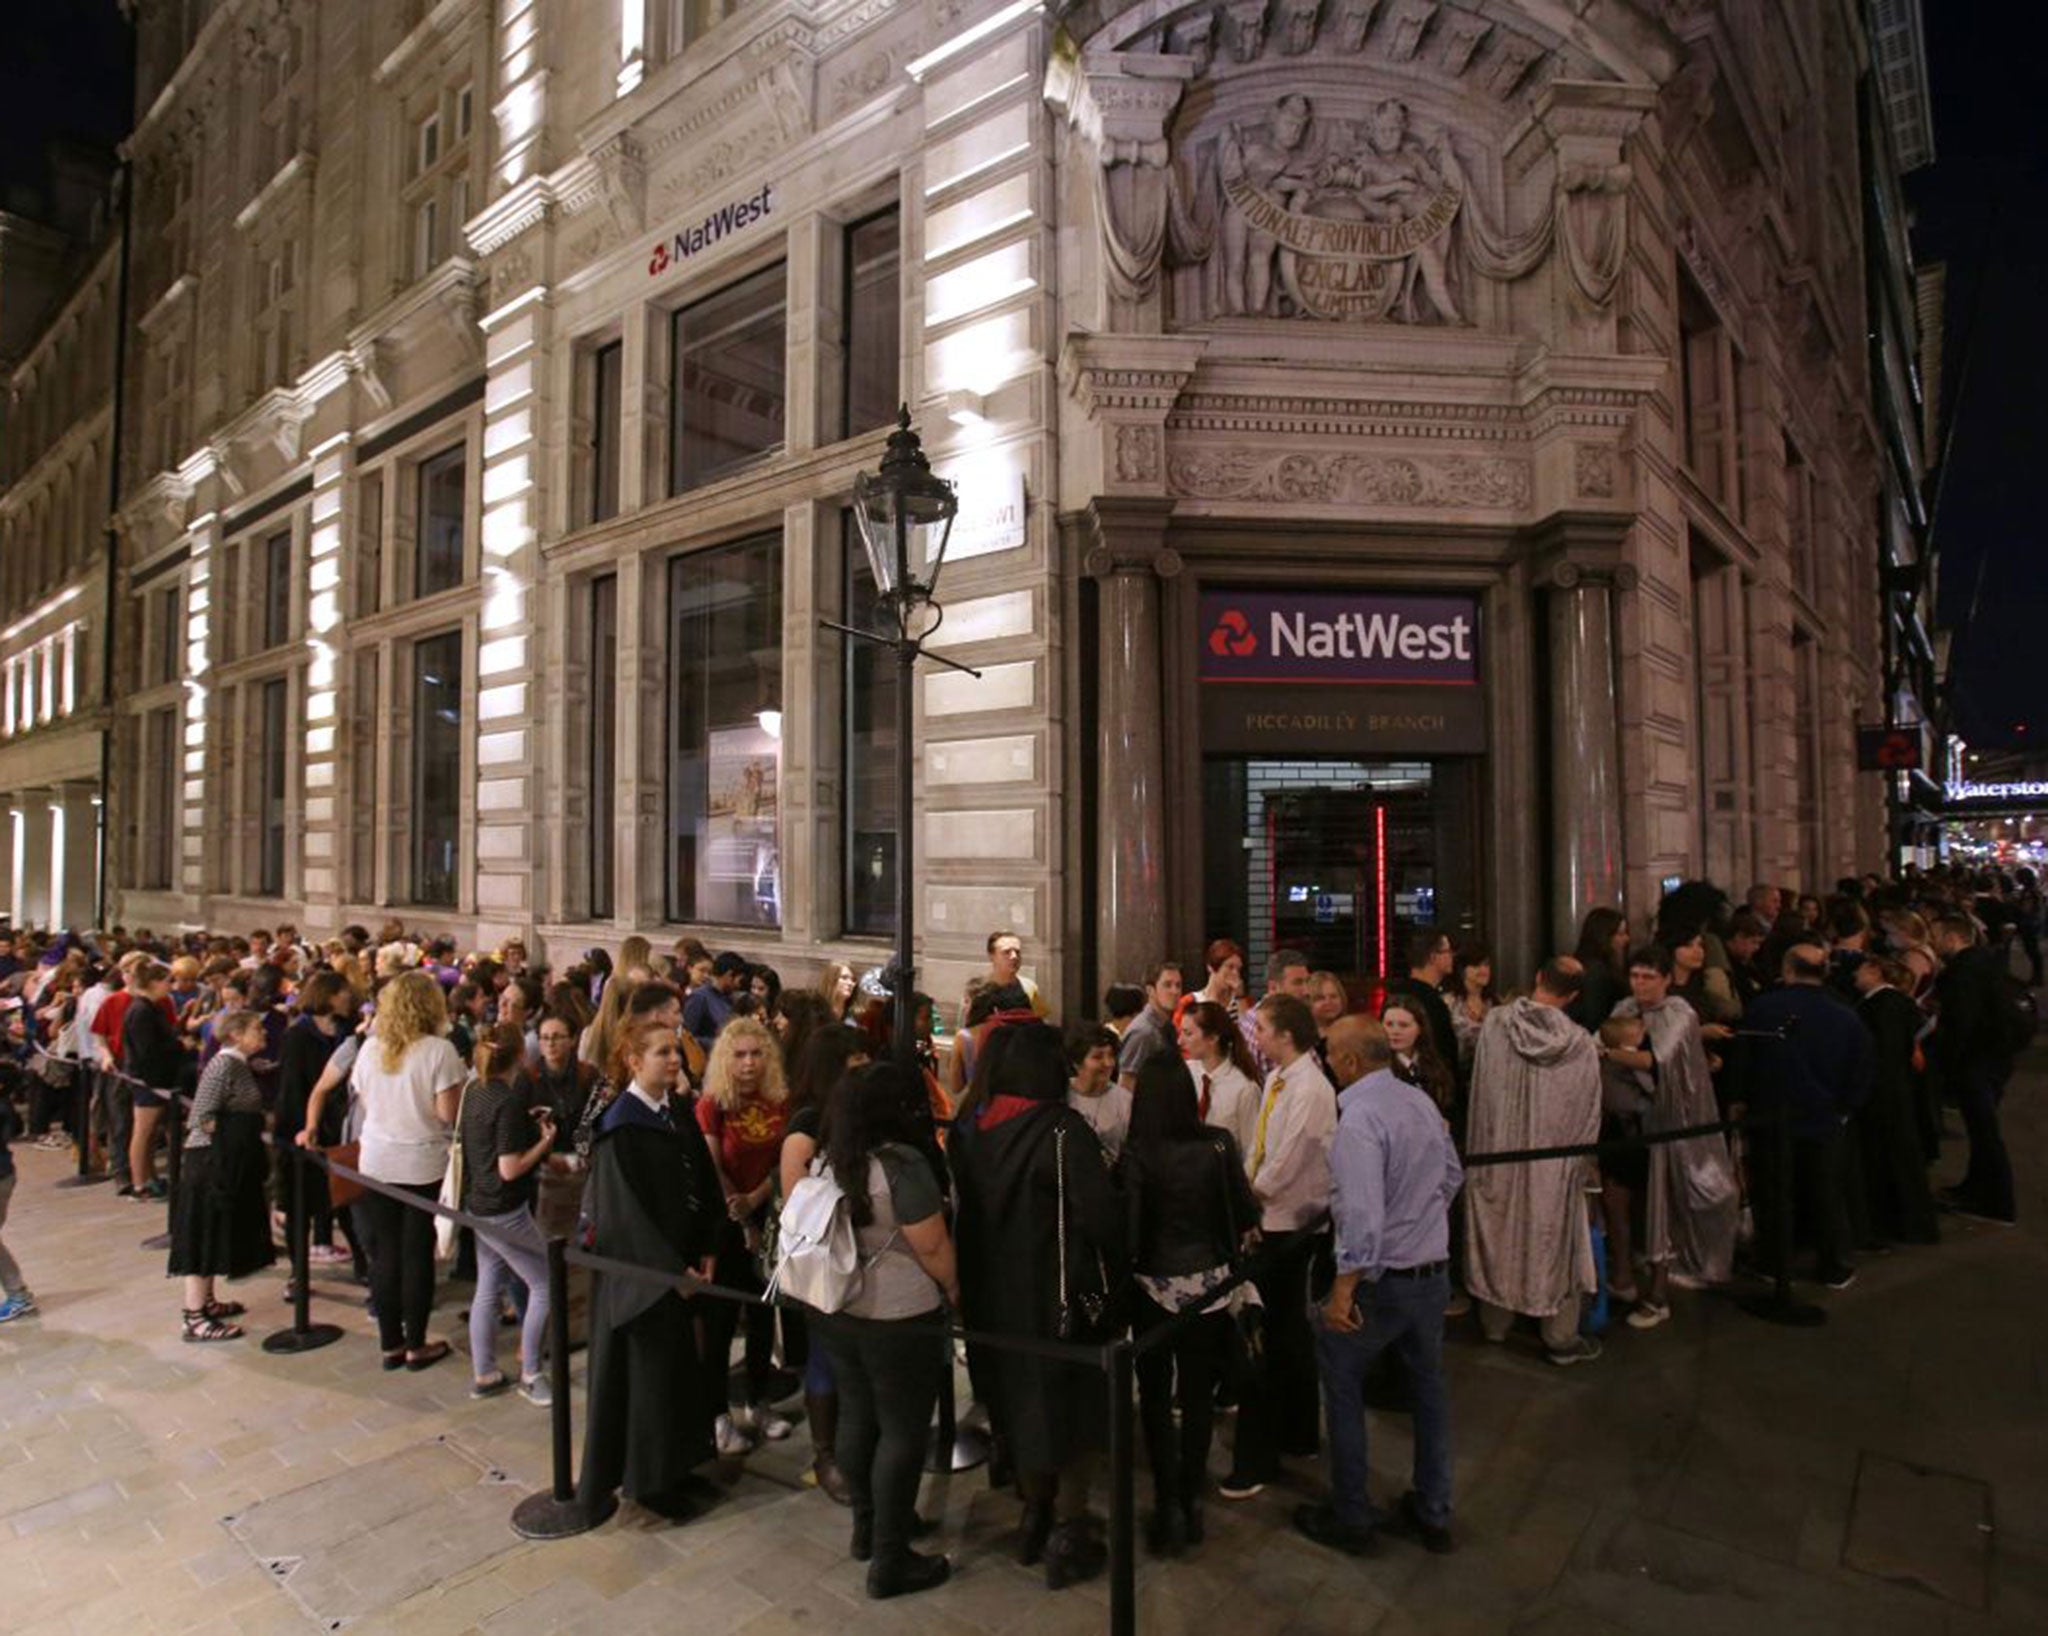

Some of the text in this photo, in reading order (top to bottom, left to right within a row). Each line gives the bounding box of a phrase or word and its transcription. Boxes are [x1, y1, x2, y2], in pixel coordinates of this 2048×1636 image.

[674, 183, 771, 262] NatWest
[1305, 218, 1418, 255] PROVINCIAL
[1298, 261, 1386, 292] ENGLAND
[1270, 611, 1471, 660] NatWest
[1246, 713, 1445, 731] PICCADILLY BRANCH
